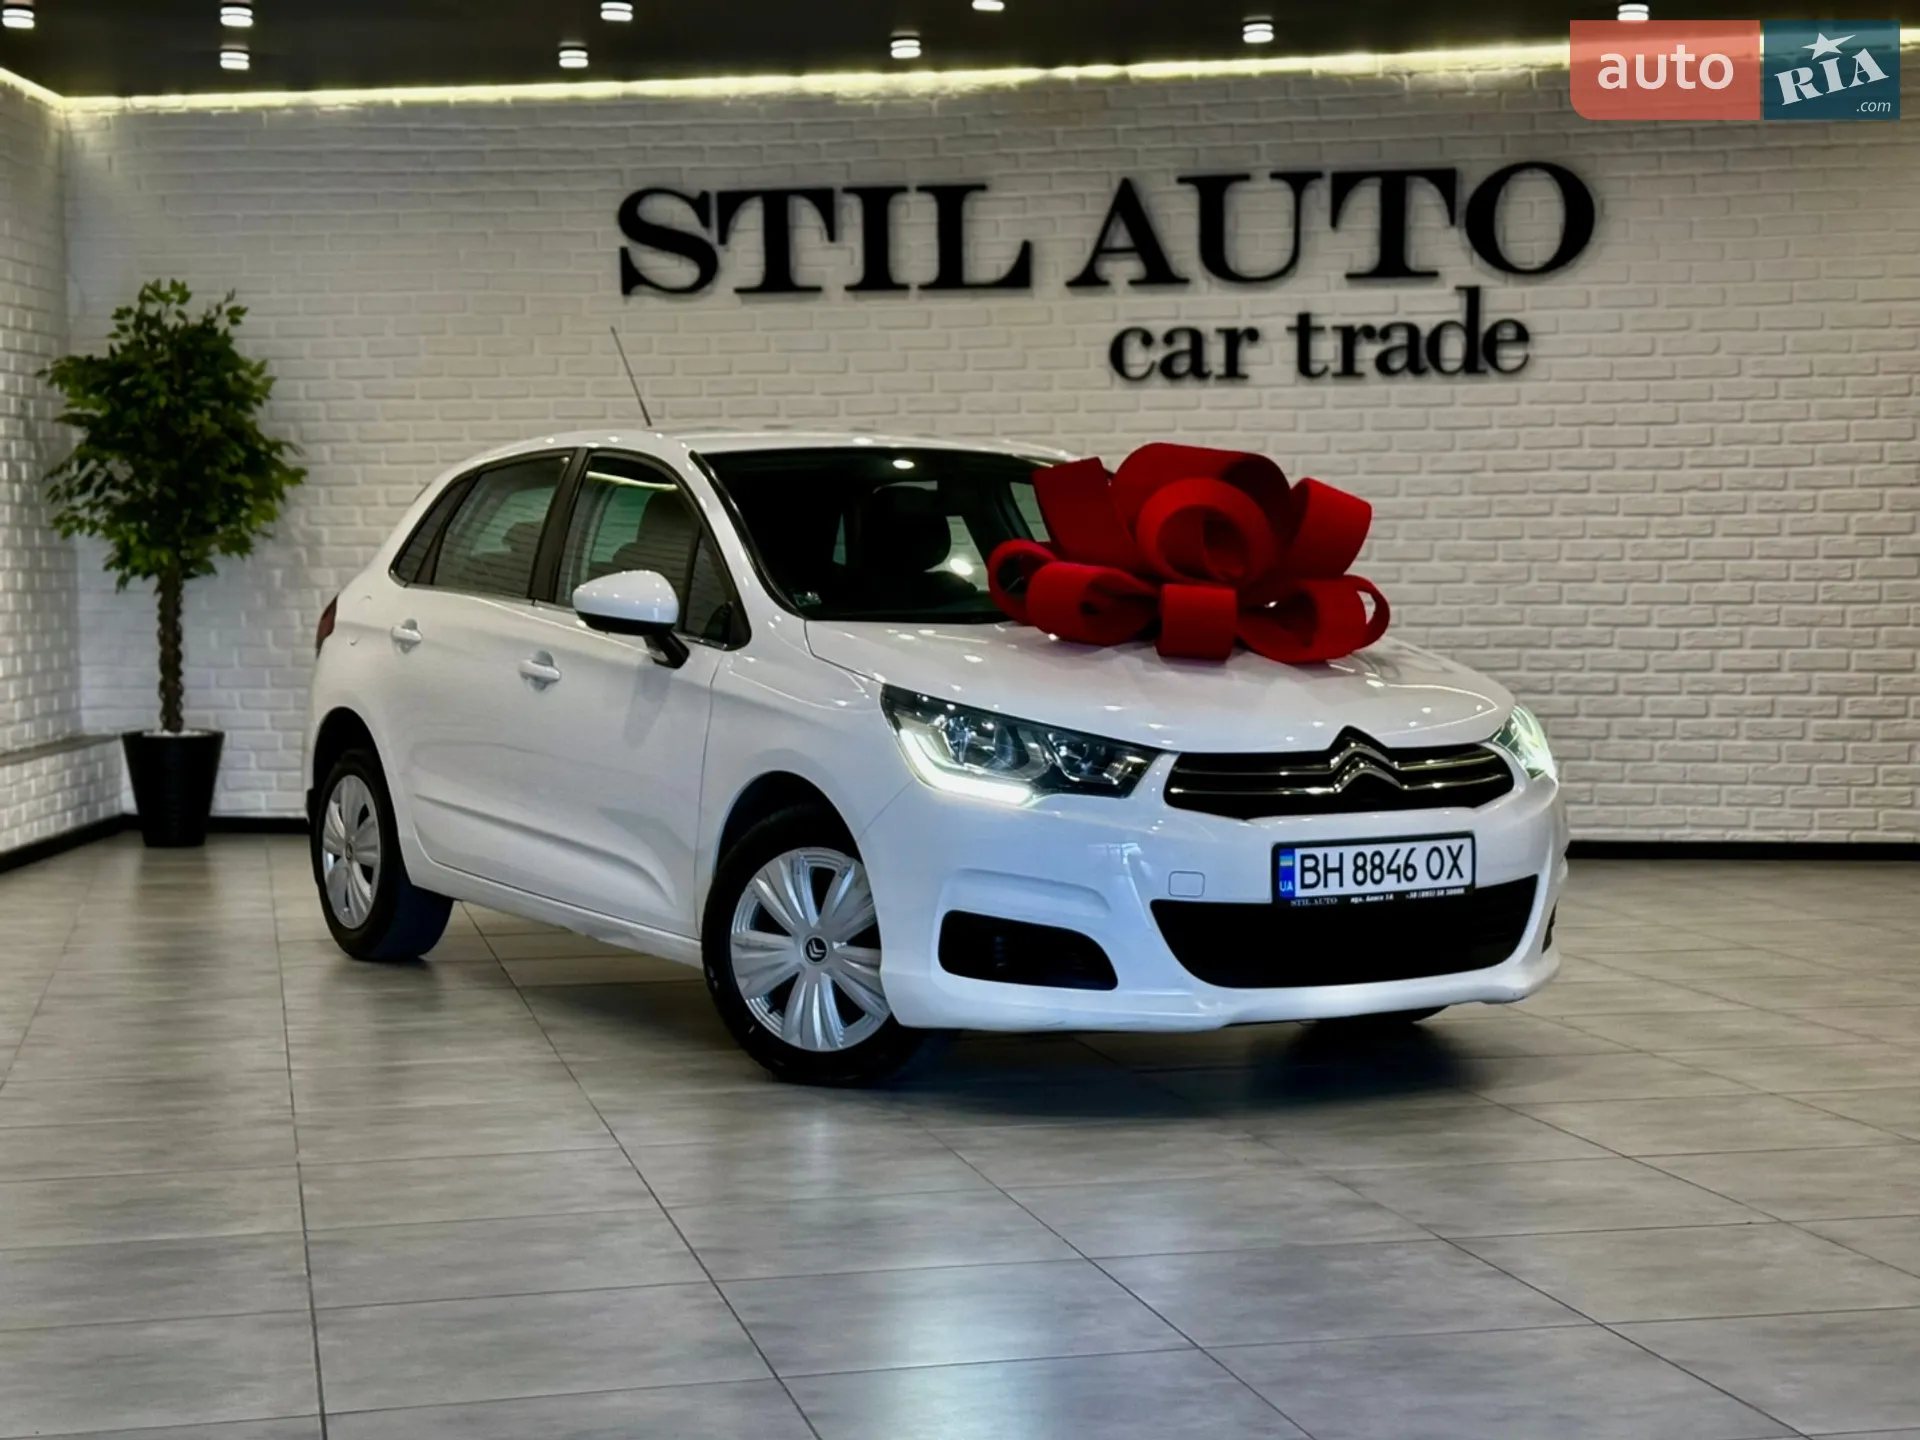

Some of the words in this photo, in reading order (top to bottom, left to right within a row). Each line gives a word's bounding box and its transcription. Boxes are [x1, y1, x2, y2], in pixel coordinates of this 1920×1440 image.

[617, 186, 1032, 296] STIL
[1066, 161, 1596, 287] AUTO
[1109, 324, 1258, 381] car
[1288, 287, 1530, 379] trade
[1279, 880, 1294, 892] UA
[1300, 852, 1344, 889] BH
[1352, 847, 1417, 886] 8846
[1426, 844, 1464, 881] OX
